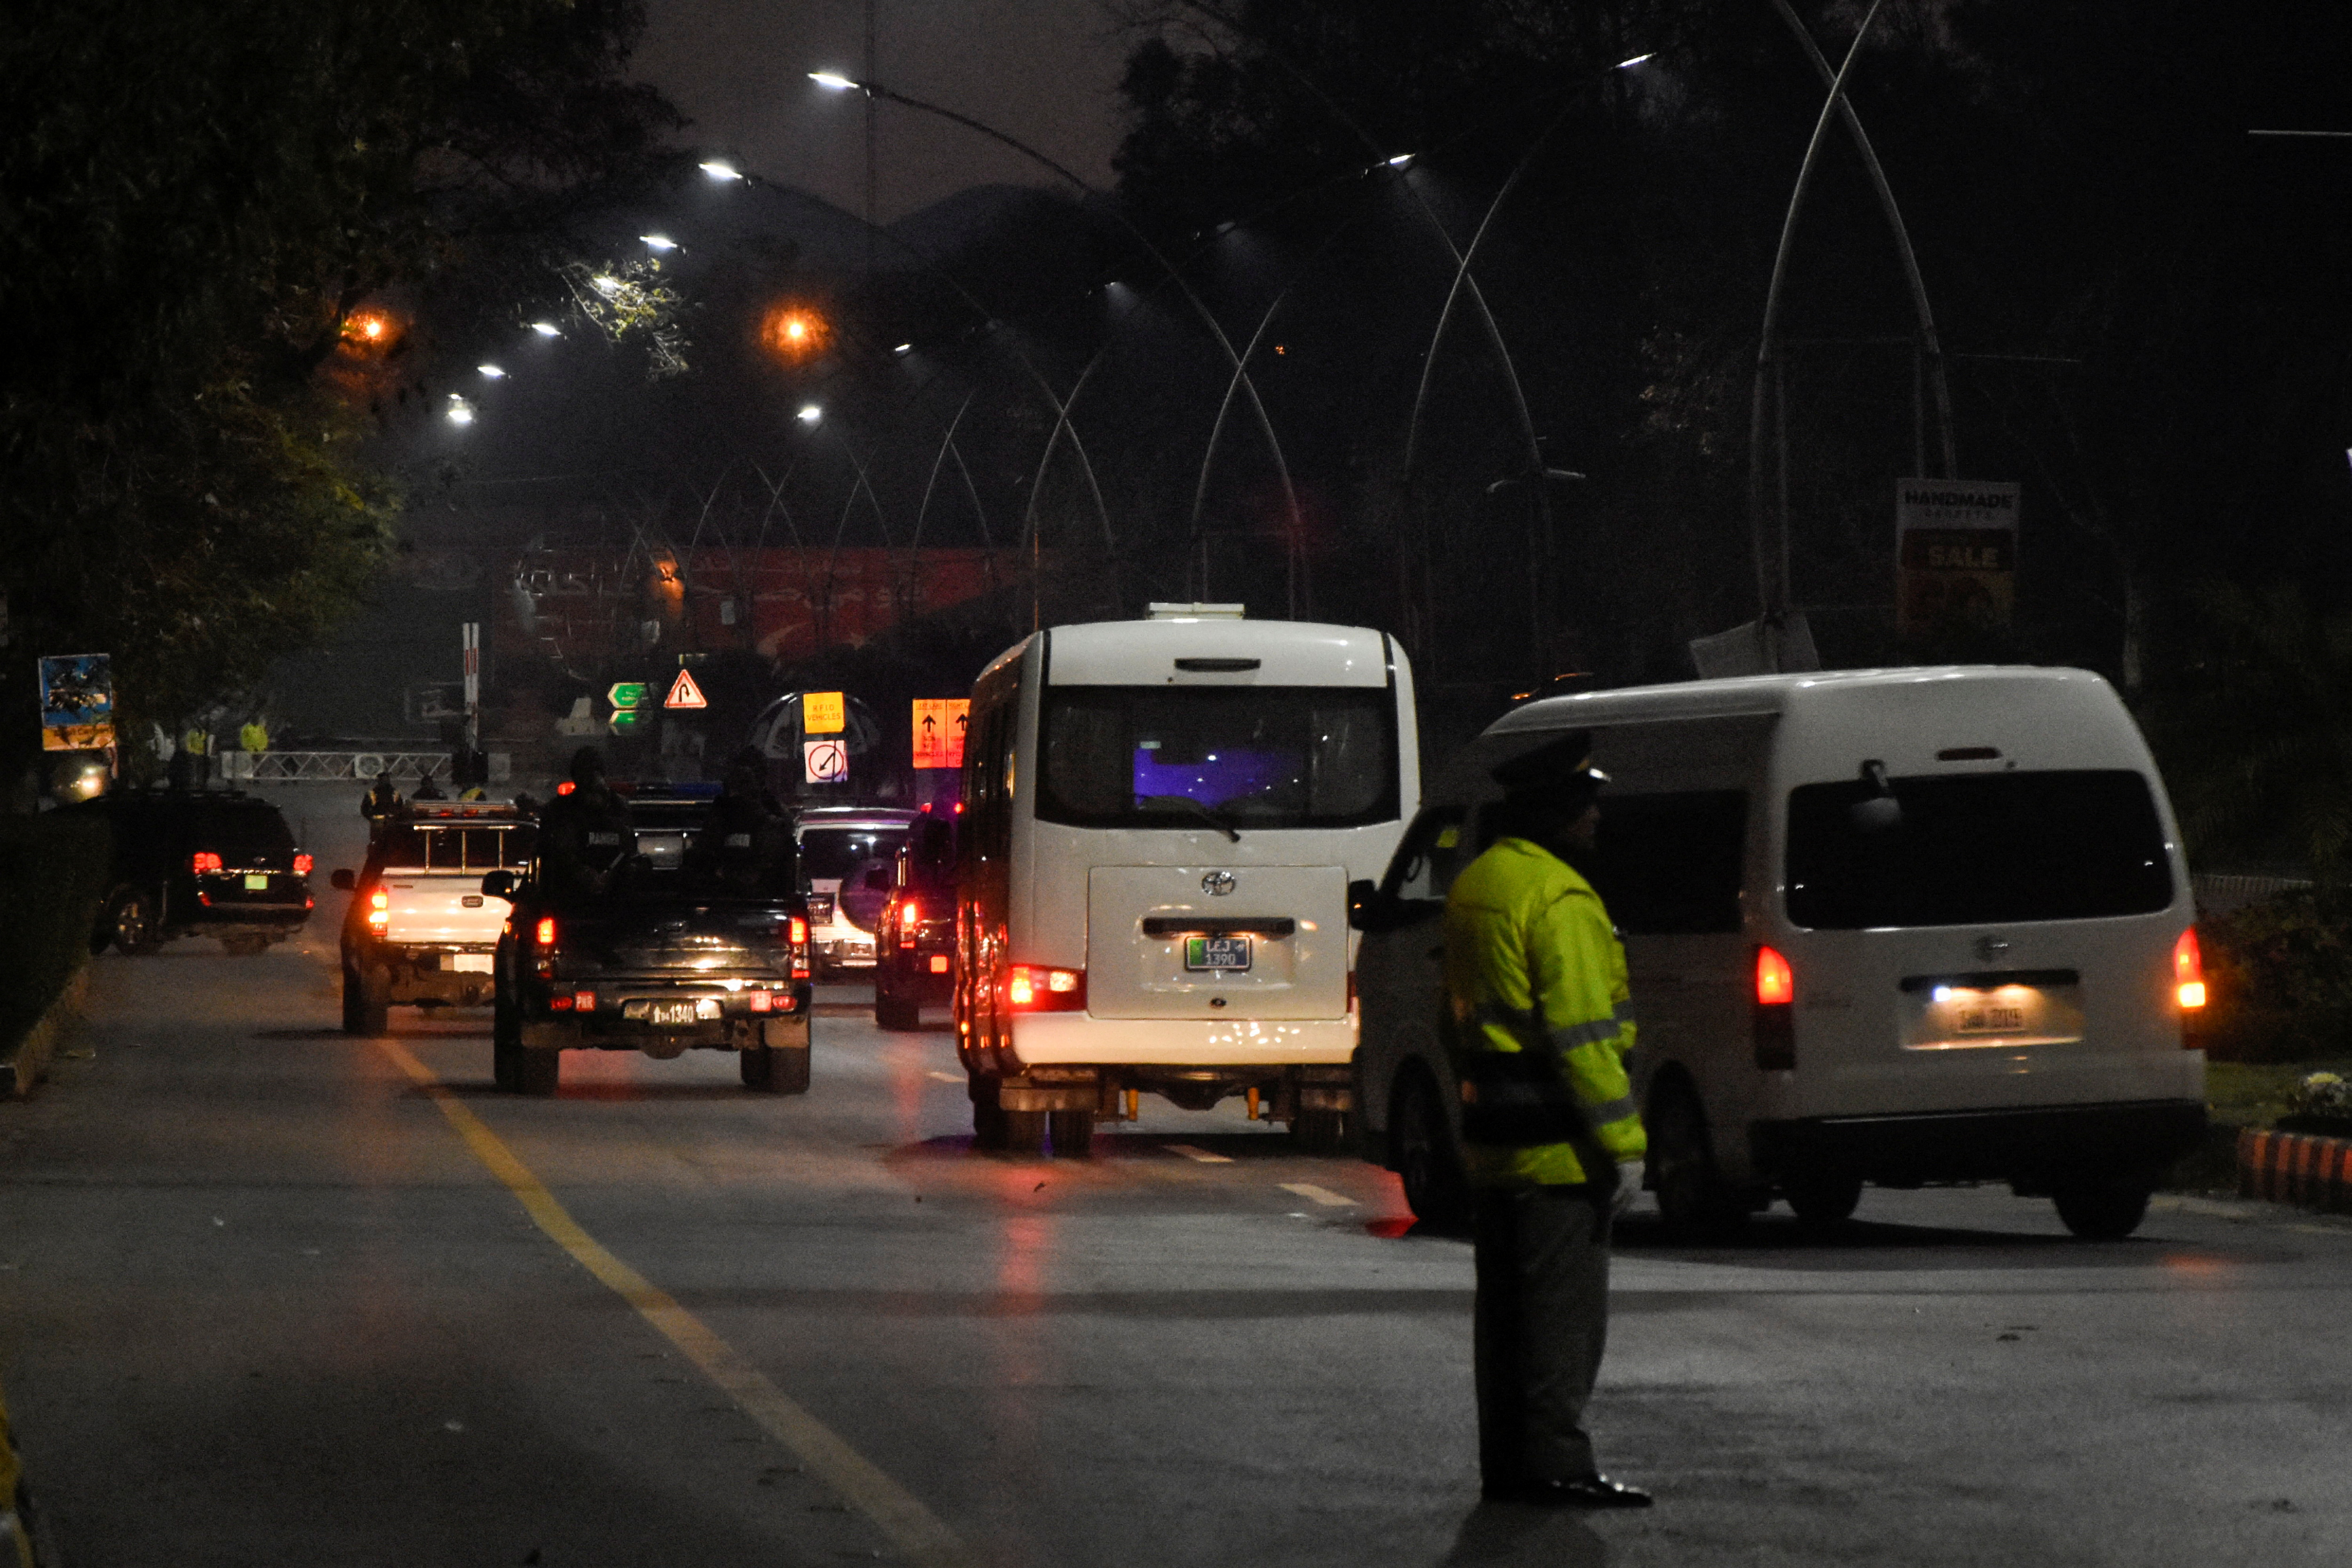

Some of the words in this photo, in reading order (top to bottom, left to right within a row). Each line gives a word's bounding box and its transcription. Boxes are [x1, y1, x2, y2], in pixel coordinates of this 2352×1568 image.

[1905, 491, 2013, 508] HANDMADE
[1928, 545, 1999, 568] SALE
[807, 713, 841, 721] VEHICLES
[1206, 953, 1236, 966] 1390
[670, 1005, 694, 1023] 1340
